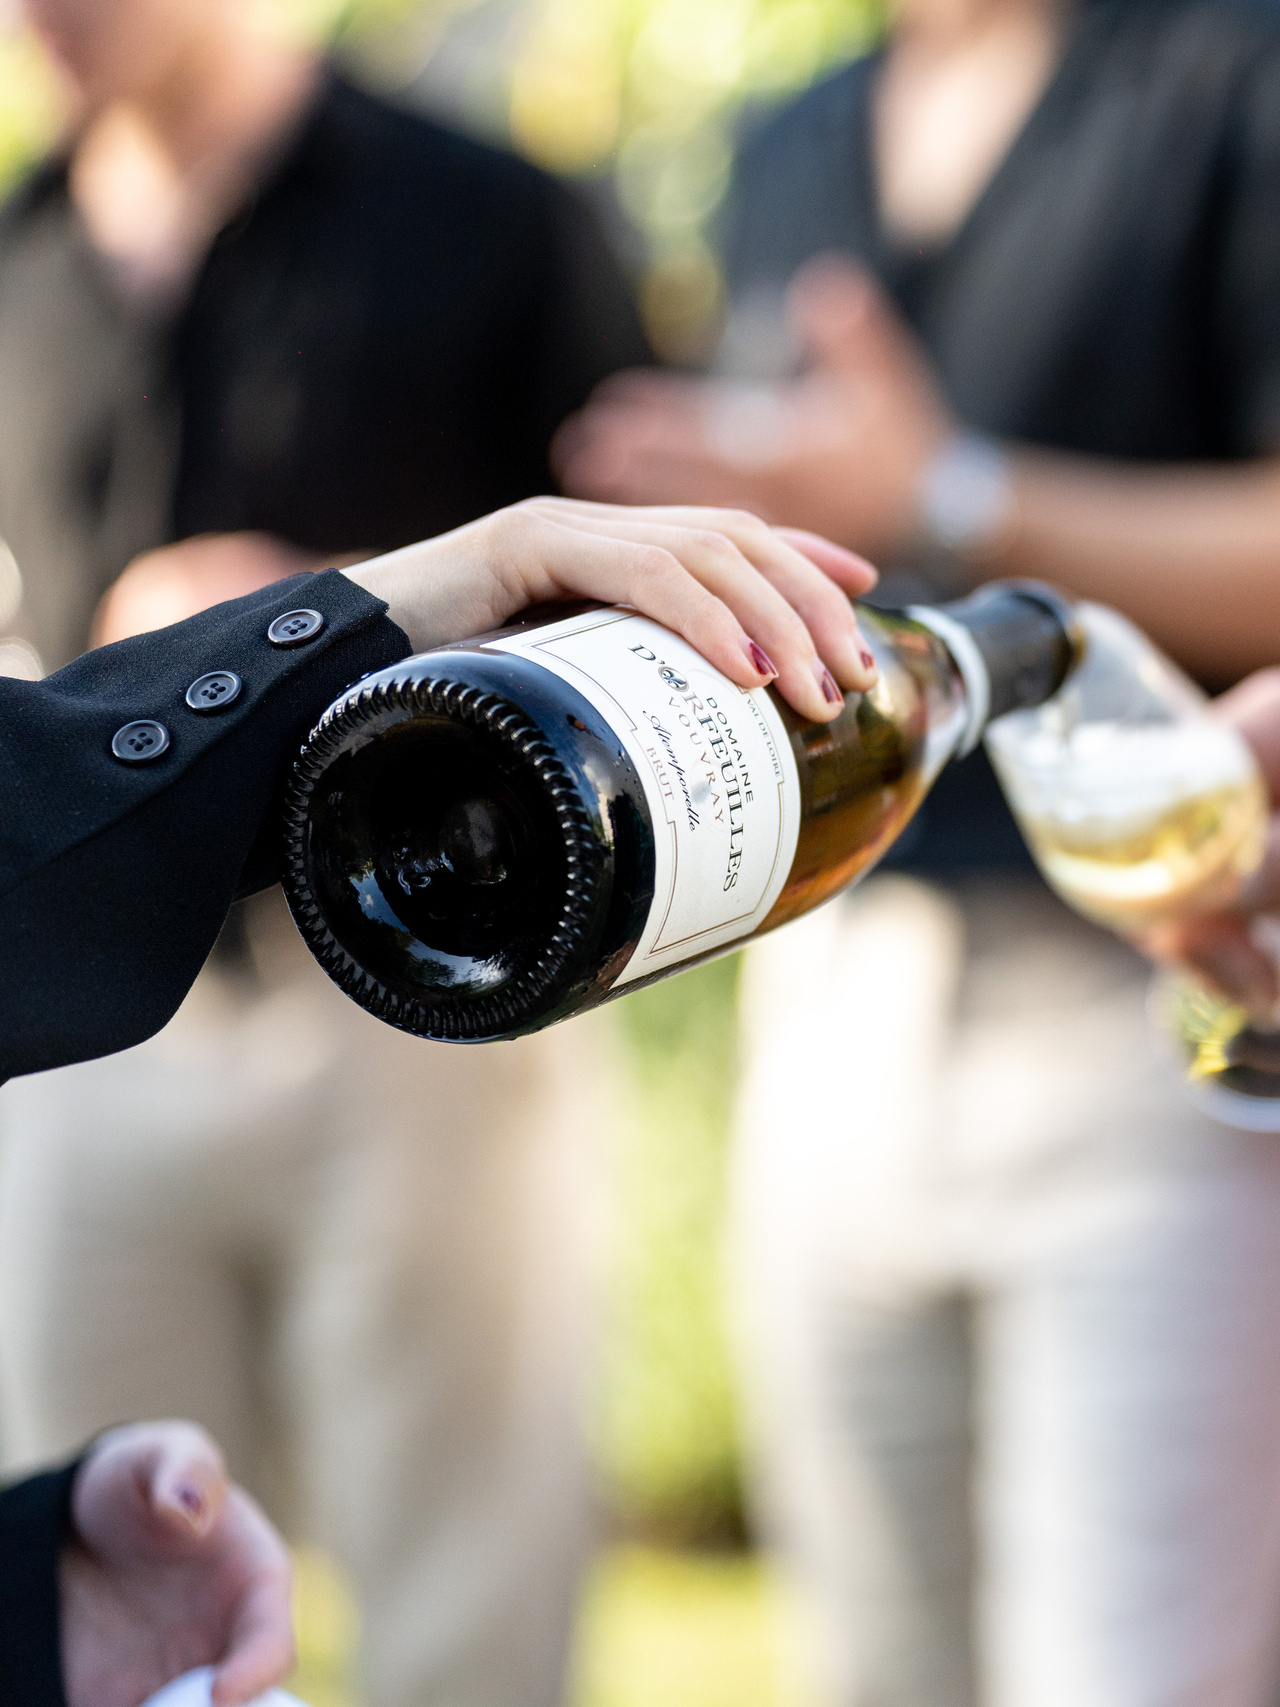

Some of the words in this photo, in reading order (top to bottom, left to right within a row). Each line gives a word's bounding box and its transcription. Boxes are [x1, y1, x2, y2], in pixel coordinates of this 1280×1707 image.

[646, 747, 674, 801] BRUT
[668, 696, 725, 823] VOUVRAY
[706, 697, 754, 803] DOMAINE
[747, 699, 760, 718] VAL
[759, 722, 770, 739] DE
[766, 741, 781, 777] LOIRE
